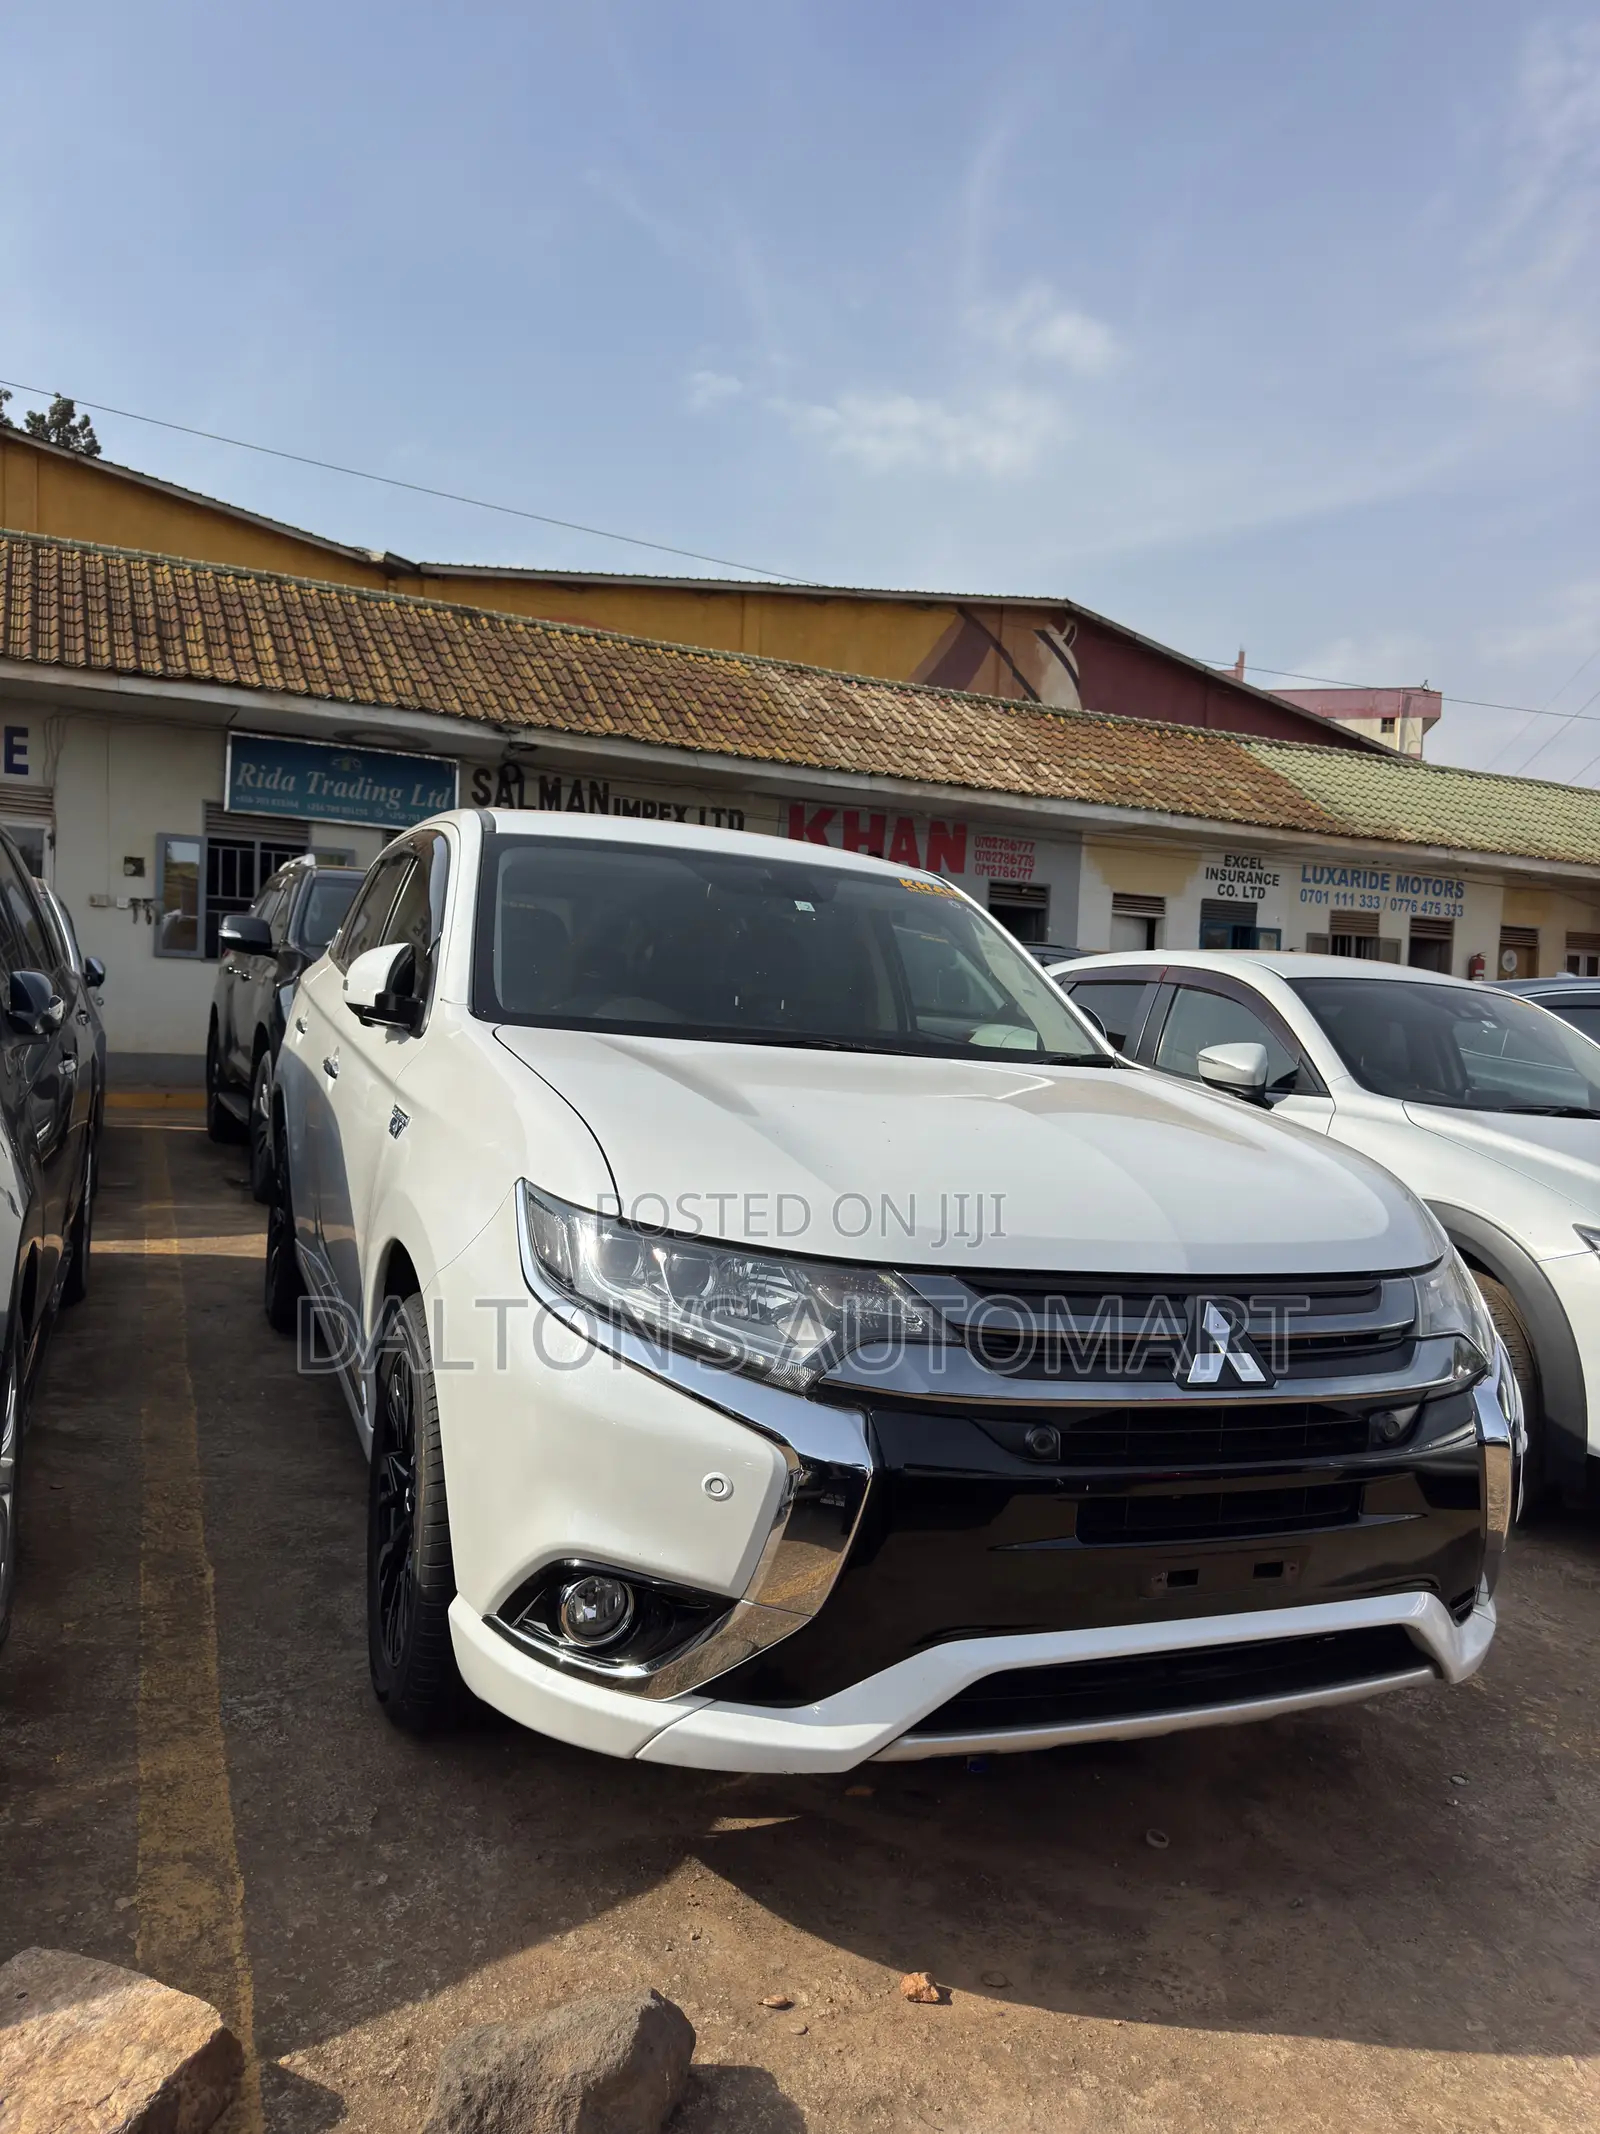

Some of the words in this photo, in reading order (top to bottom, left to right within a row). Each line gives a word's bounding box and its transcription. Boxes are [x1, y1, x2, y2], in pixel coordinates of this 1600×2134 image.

[236, 761, 296, 792] Rida
[306, 771, 404, 810] Trading
[410, 783, 452, 809] Ltd
[471, 767, 609, 815] SALMAN
[613, 797, 689, 823] IMPEX
[788, 804, 968, 874] KHAN
[1205, 866, 1280, 887] INSURANCE
[1224, 854, 1264, 870] EXCEL
[1217, 883, 1238, 898] CO.
[1242, 885, 1266, 899] LTD
[1301, 864, 1391, 891] LUXARIDE
[1395, 874, 1465, 899] MOTORS
[1300, 888, 1330, 905] 0701
[1334, 891, 1354, 907] 111
[1359, 894, 1380, 909] 333
[1390, 897, 1418, 913] 0776
[1421, 900, 1441, 916] 475
[1444, 902, 1464, 918] 333
